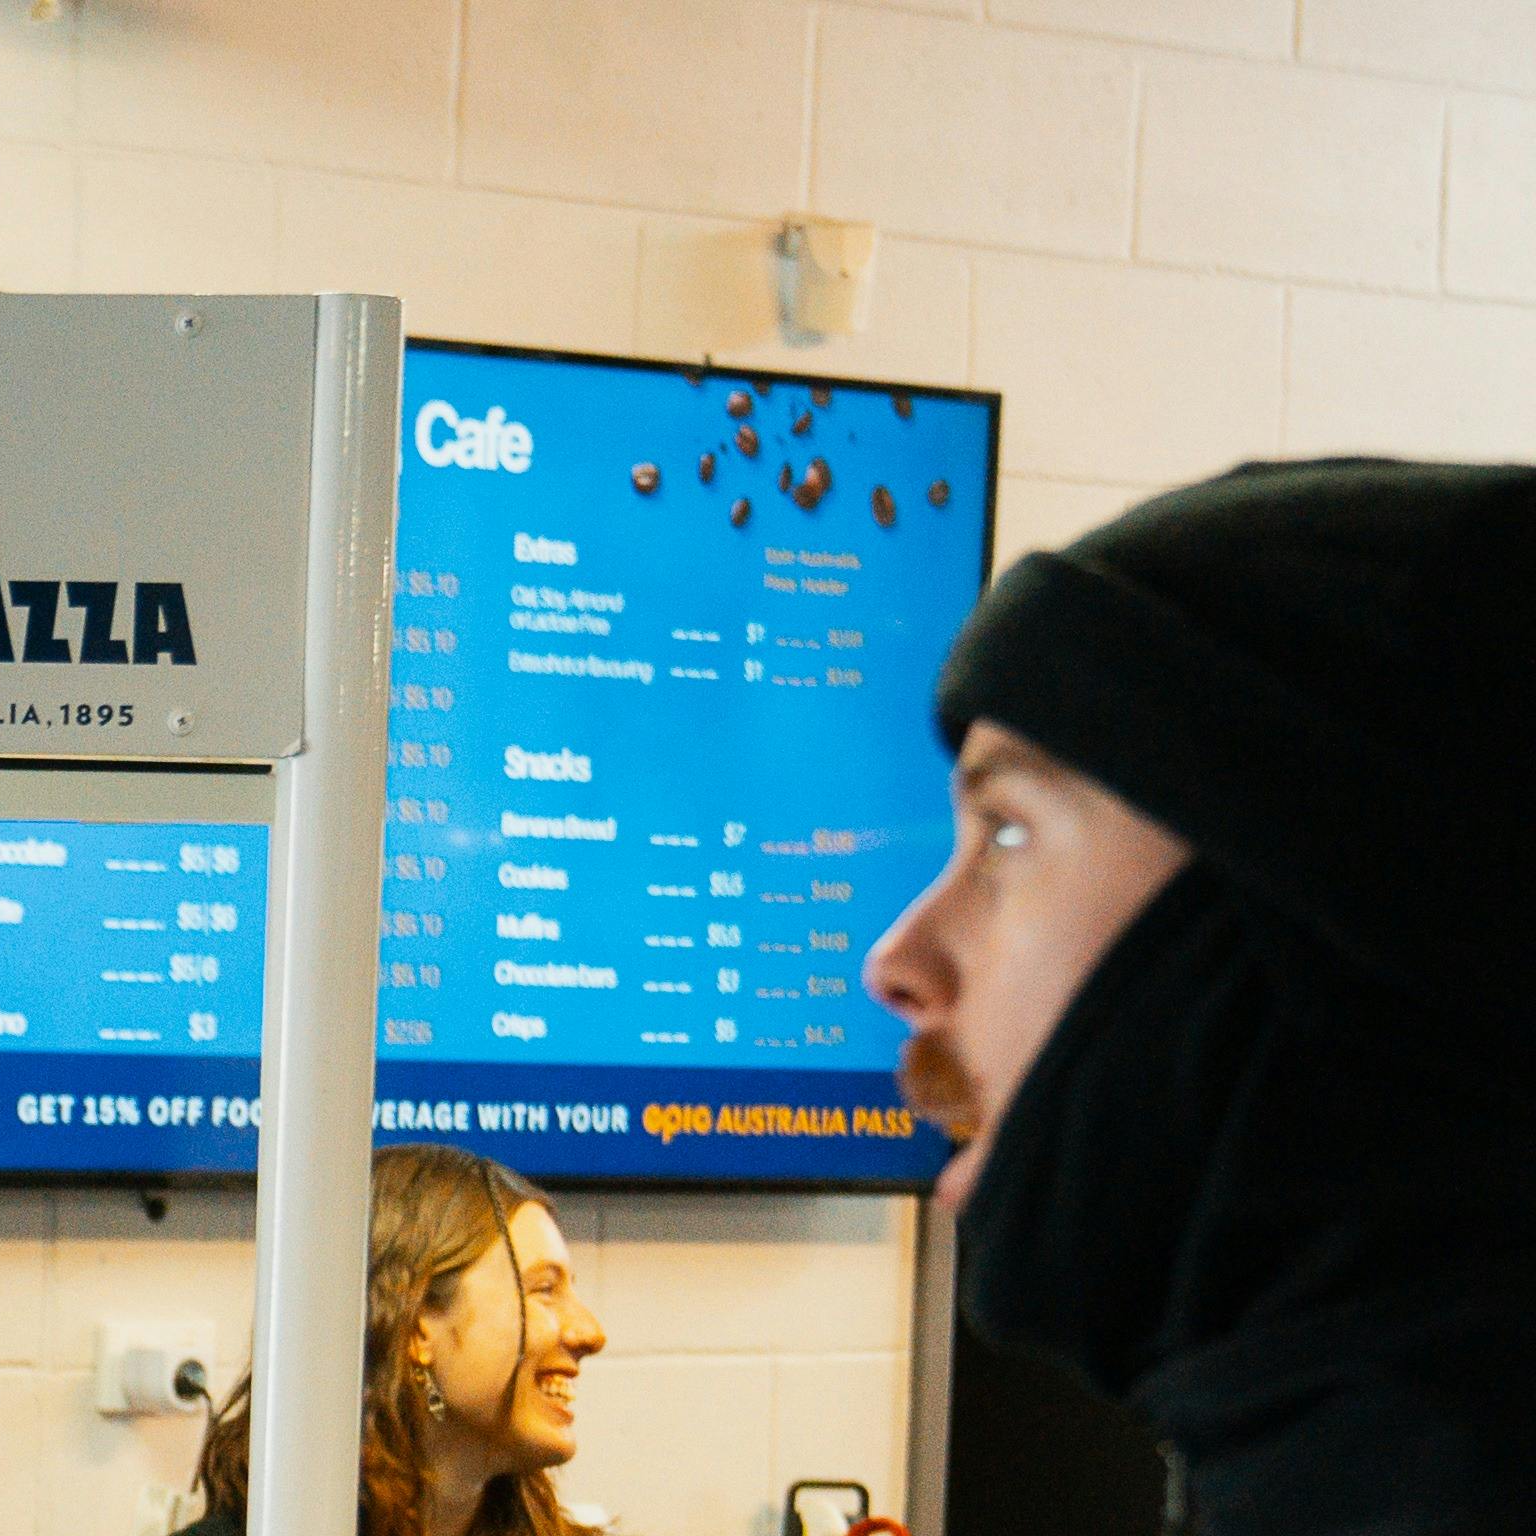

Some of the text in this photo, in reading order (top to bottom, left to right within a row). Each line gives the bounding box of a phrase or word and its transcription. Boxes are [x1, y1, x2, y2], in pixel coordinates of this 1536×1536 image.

[415, 399, 534, 474] Cafe
[60, 703, 134, 727] 1895
[504, 744, 592, 783] Snacks
[17, 1093, 262, 1128] GET 15% OFF FOO
[372, 1099, 470, 1131] ERAGE
[478, 1102, 549, 1133] WITH
[555, 1104, 628, 1134] YOUR
[716, 1104, 847, 1137] AUSTRALIA
[852, 1106, 916, 1139] PASS
